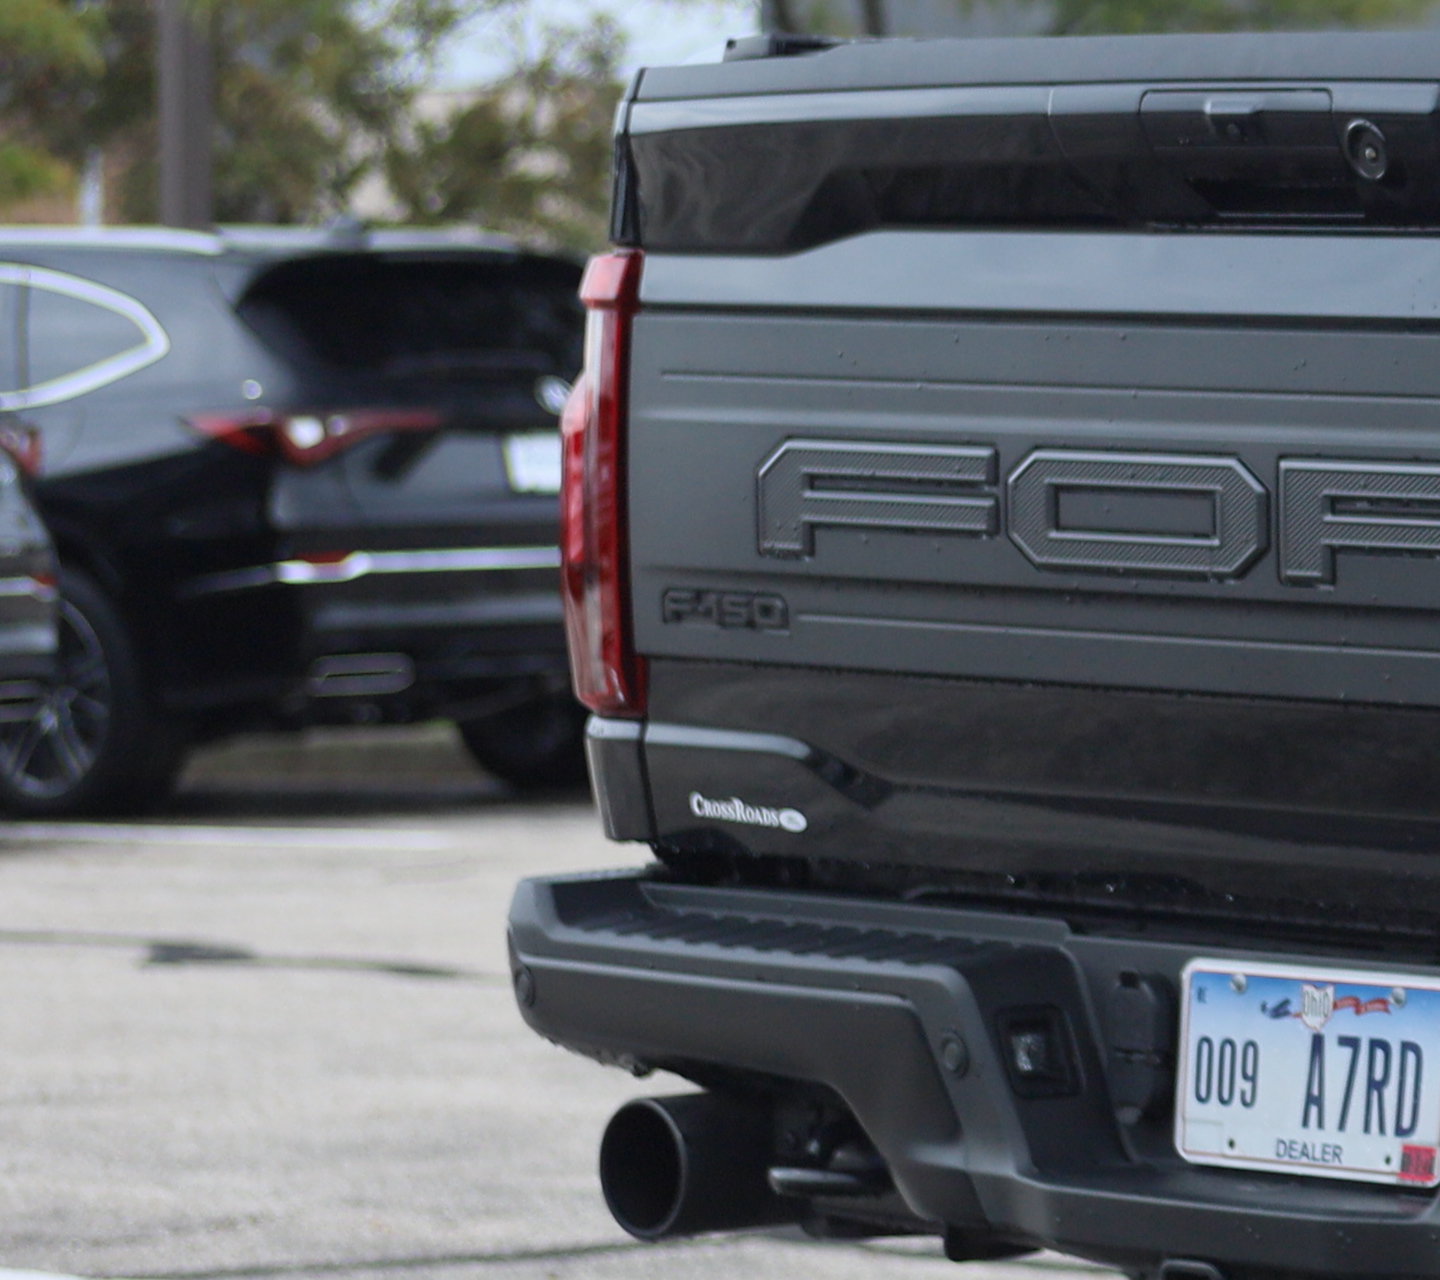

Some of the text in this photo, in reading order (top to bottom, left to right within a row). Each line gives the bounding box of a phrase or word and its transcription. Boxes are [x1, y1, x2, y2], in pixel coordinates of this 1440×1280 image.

[1194, 1032, 1424, 1138] 009 A7RD
[1275, 1138, 1343, 1164] DEALER
